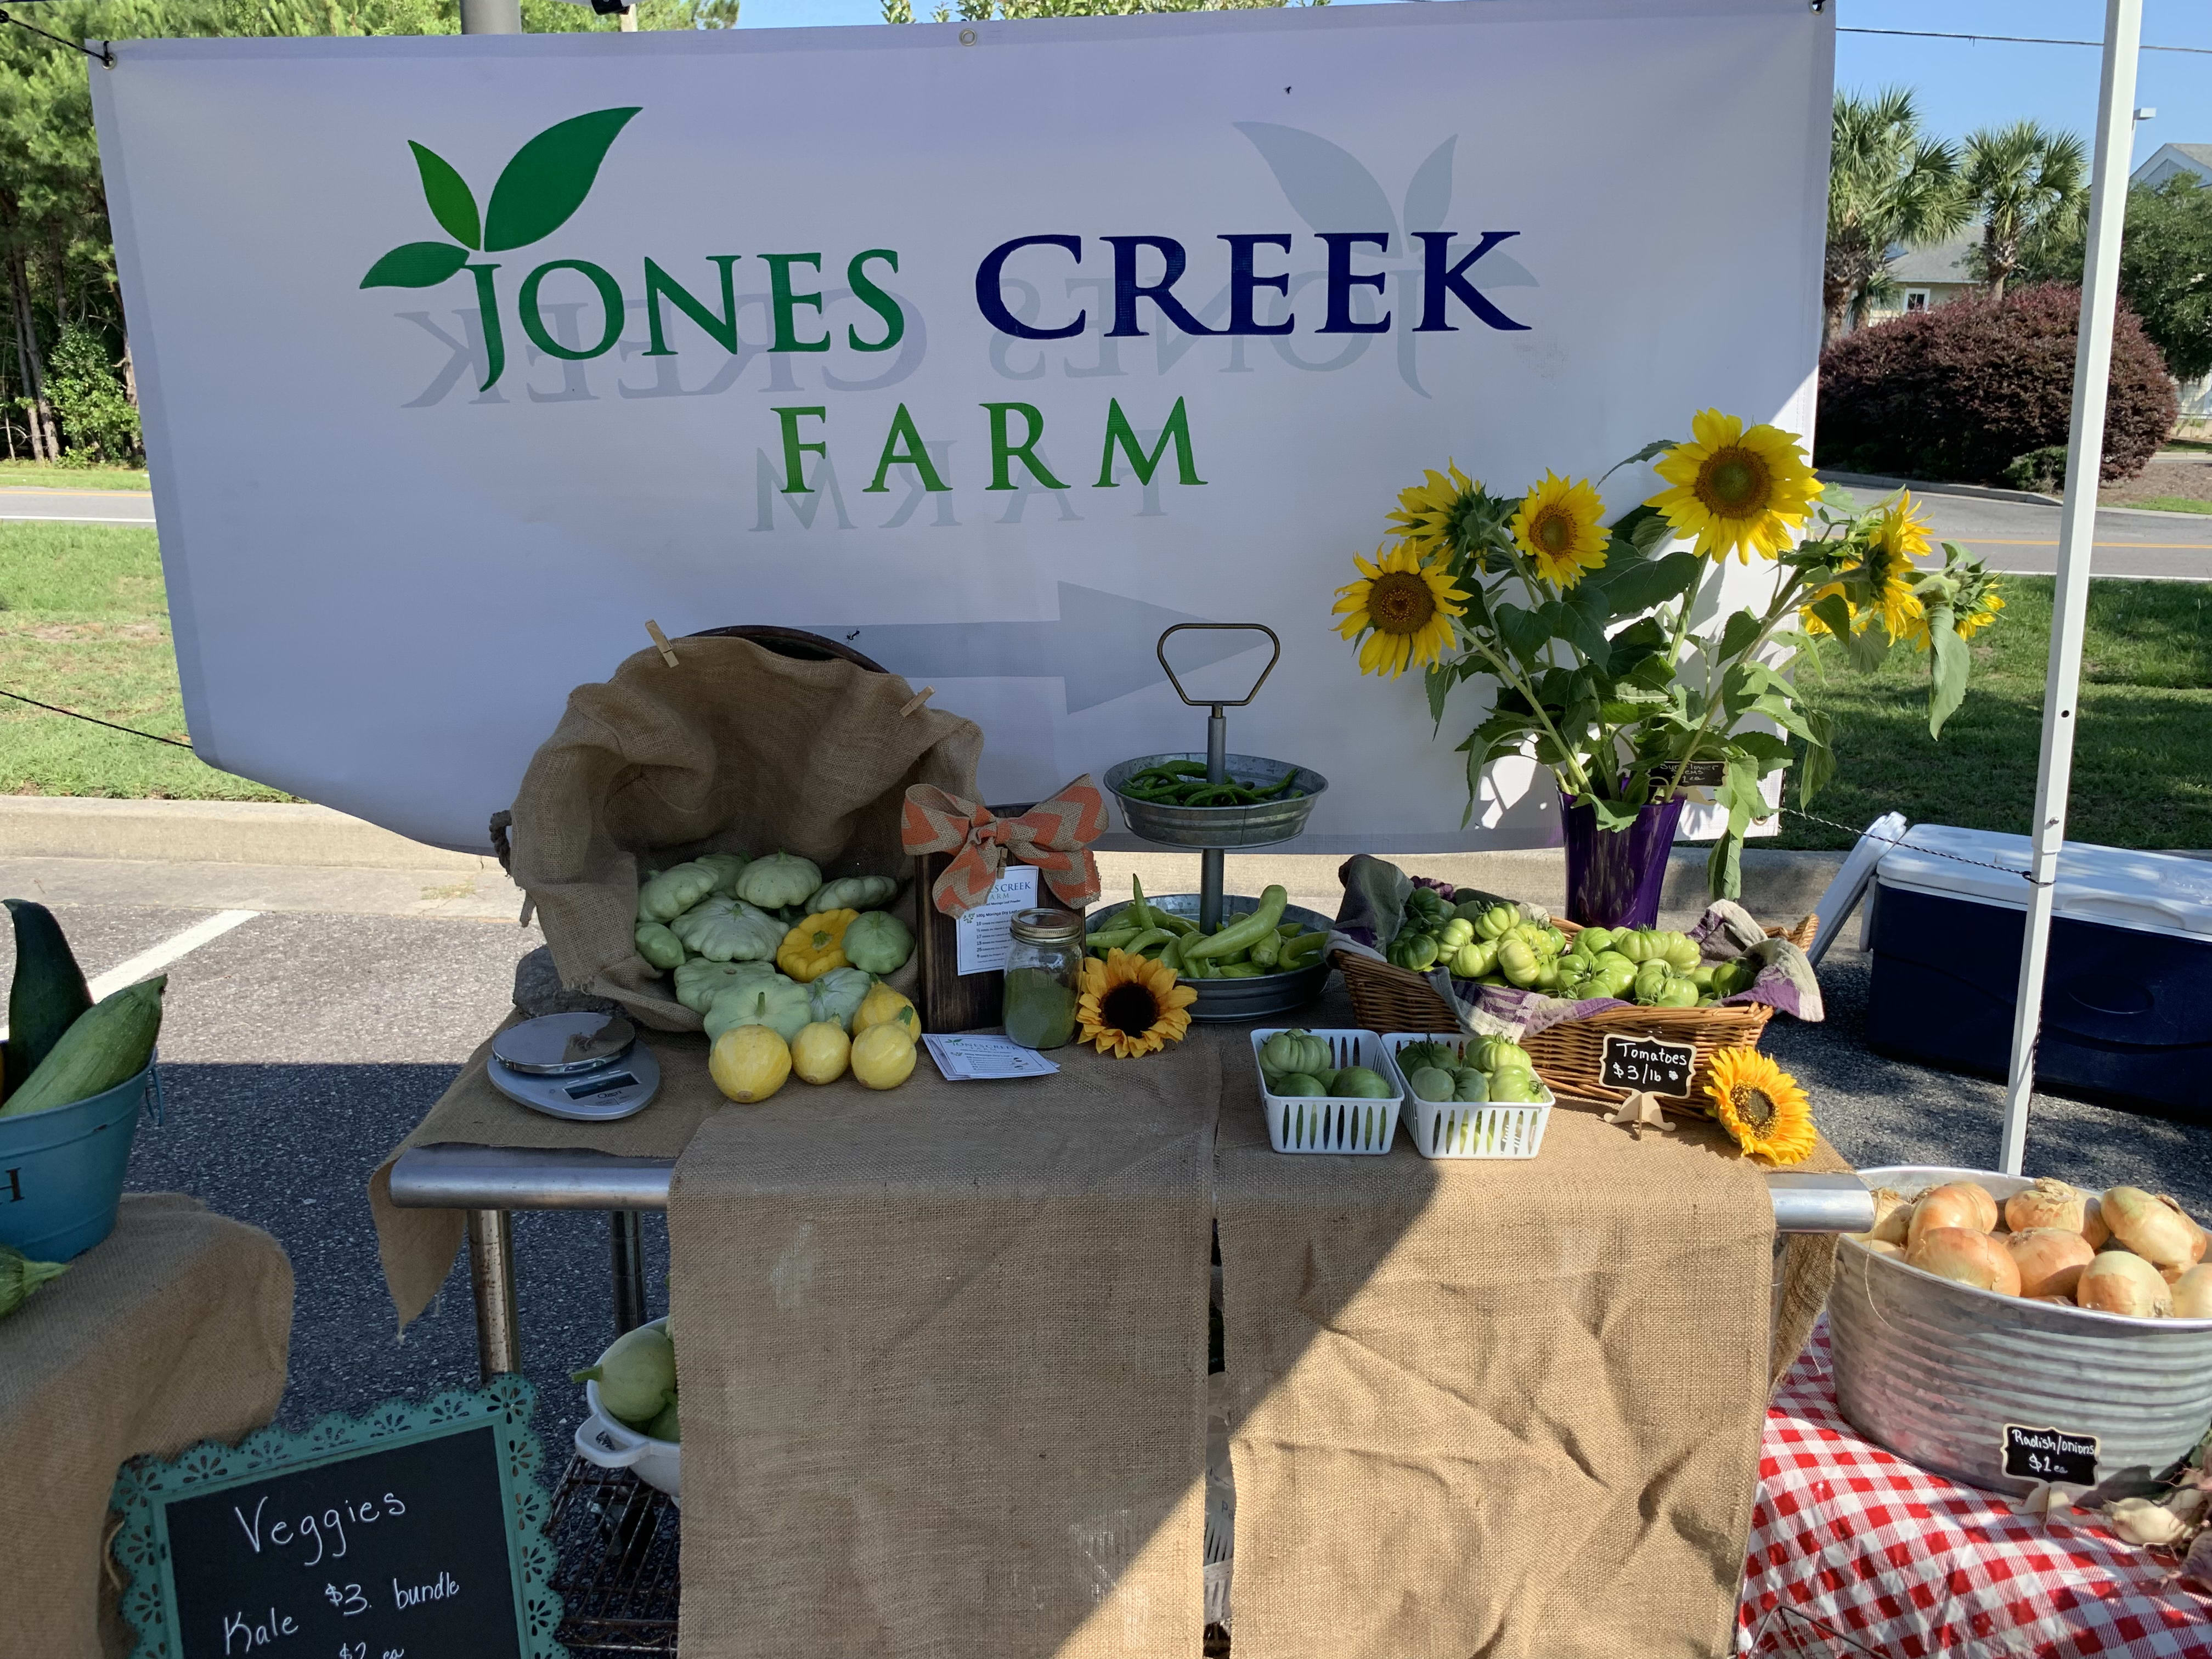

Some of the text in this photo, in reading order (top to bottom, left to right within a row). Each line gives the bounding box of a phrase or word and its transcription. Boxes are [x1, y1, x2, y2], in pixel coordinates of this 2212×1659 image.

[458, 230, 1533, 393] JONES CREEK
[770, 396, 1209, 494] FARM
[1001, 881, 1031, 892] CREEK
[1616, 1042, 1688, 1066] Tomatoes
[2011, 1428, 2095, 1455] Radish/onions
[2029, 1452, 2052, 1473] $1
[234, 1490, 406, 1566] Veggies
[223, 1606, 300, 1655] Kale
[392, 1571, 460, 1611] bundle
